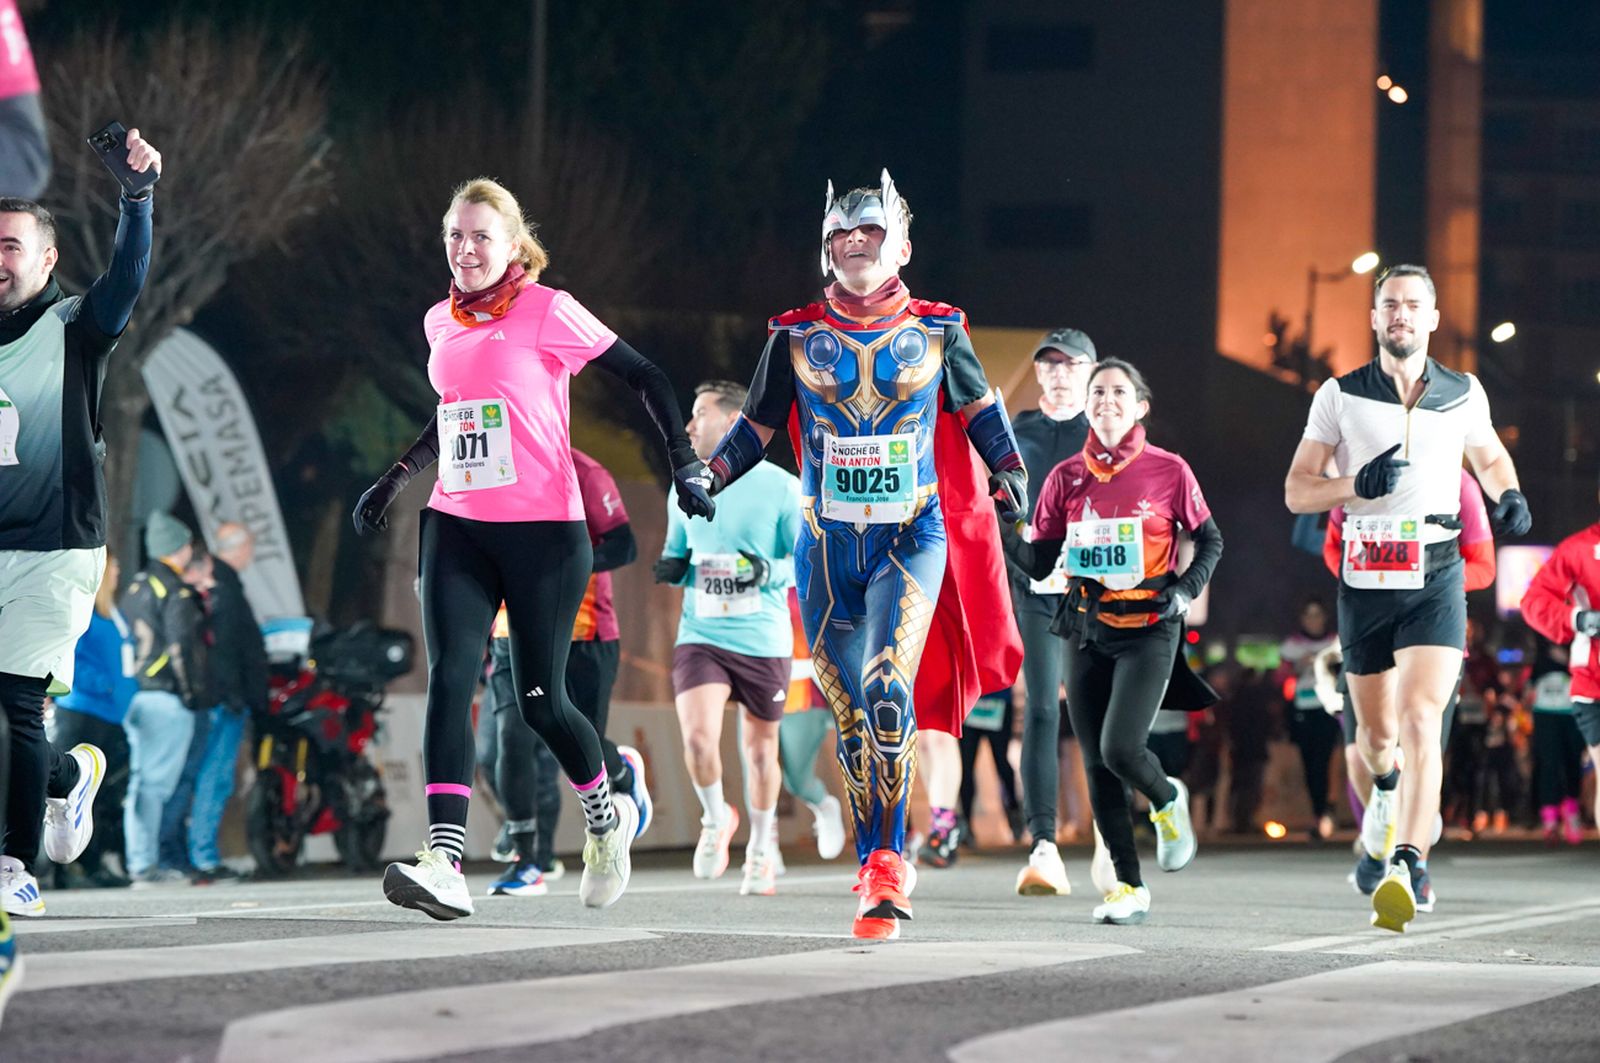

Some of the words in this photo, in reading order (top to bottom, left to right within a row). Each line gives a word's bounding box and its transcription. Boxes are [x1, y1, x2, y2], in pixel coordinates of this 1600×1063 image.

[838, 446, 867, 455] NOCHE
[869, 446, 880, 454] DE
[200, 372, 284, 563] JAPEMASA
[831, 455, 846, 466] SAN
[848, 456, 880, 466] ANTÓN
[836, 467, 900, 494] 9025
[846, 495, 875, 503] Francisco
[1080, 545, 1126, 568] 9618
